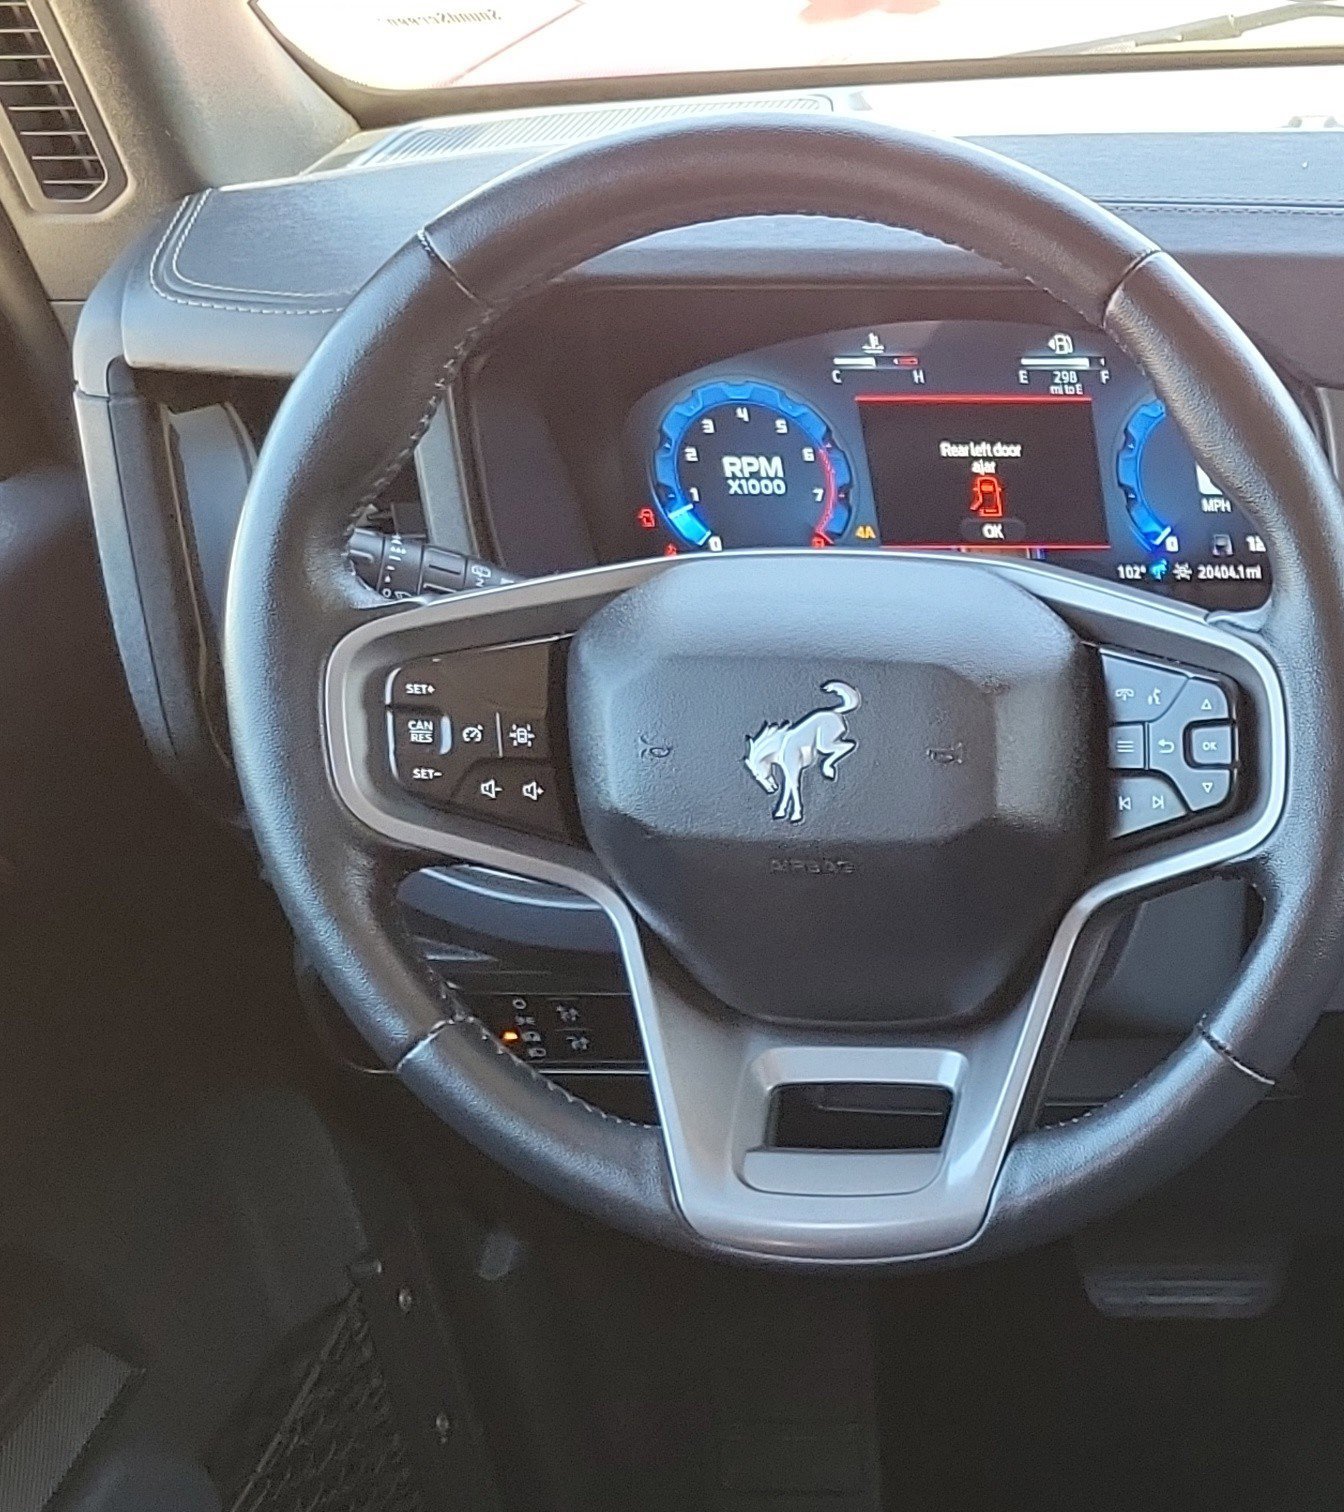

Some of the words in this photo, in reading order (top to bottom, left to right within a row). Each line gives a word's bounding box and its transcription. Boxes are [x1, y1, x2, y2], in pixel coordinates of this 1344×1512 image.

[831, 371, 842, 385] C
[913, 371, 925, 385] H
[1018, 371, 1029, 385] E
[1101, 371, 1110, 385] F
[736, 407, 749, 422] 4
[702, 419, 715, 434] 3
[774, 419, 788, 434] 5
[685, 447, 698, 462] 2
[801, 447, 815, 462] 6
[940, 443, 970, 458] Rear
[970, 442, 994, 457] left
[994, 442, 1021, 458] door
[722, 456, 784, 478] RPM
[971, 461, 996, 475] ajar
[728, 478, 786, 495] X1000
[690, 488, 699, 501] 1
[813, 488, 824, 501] 7
[1202, 498, 1231, 512] MPH
[855, 526, 876, 539] 4A
[982, 525, 1004, 539] OK
[408, 720, 433, 730] CAN
[410, 733, 433, 743] RES
[1202, 741, 1217, 751] OK
